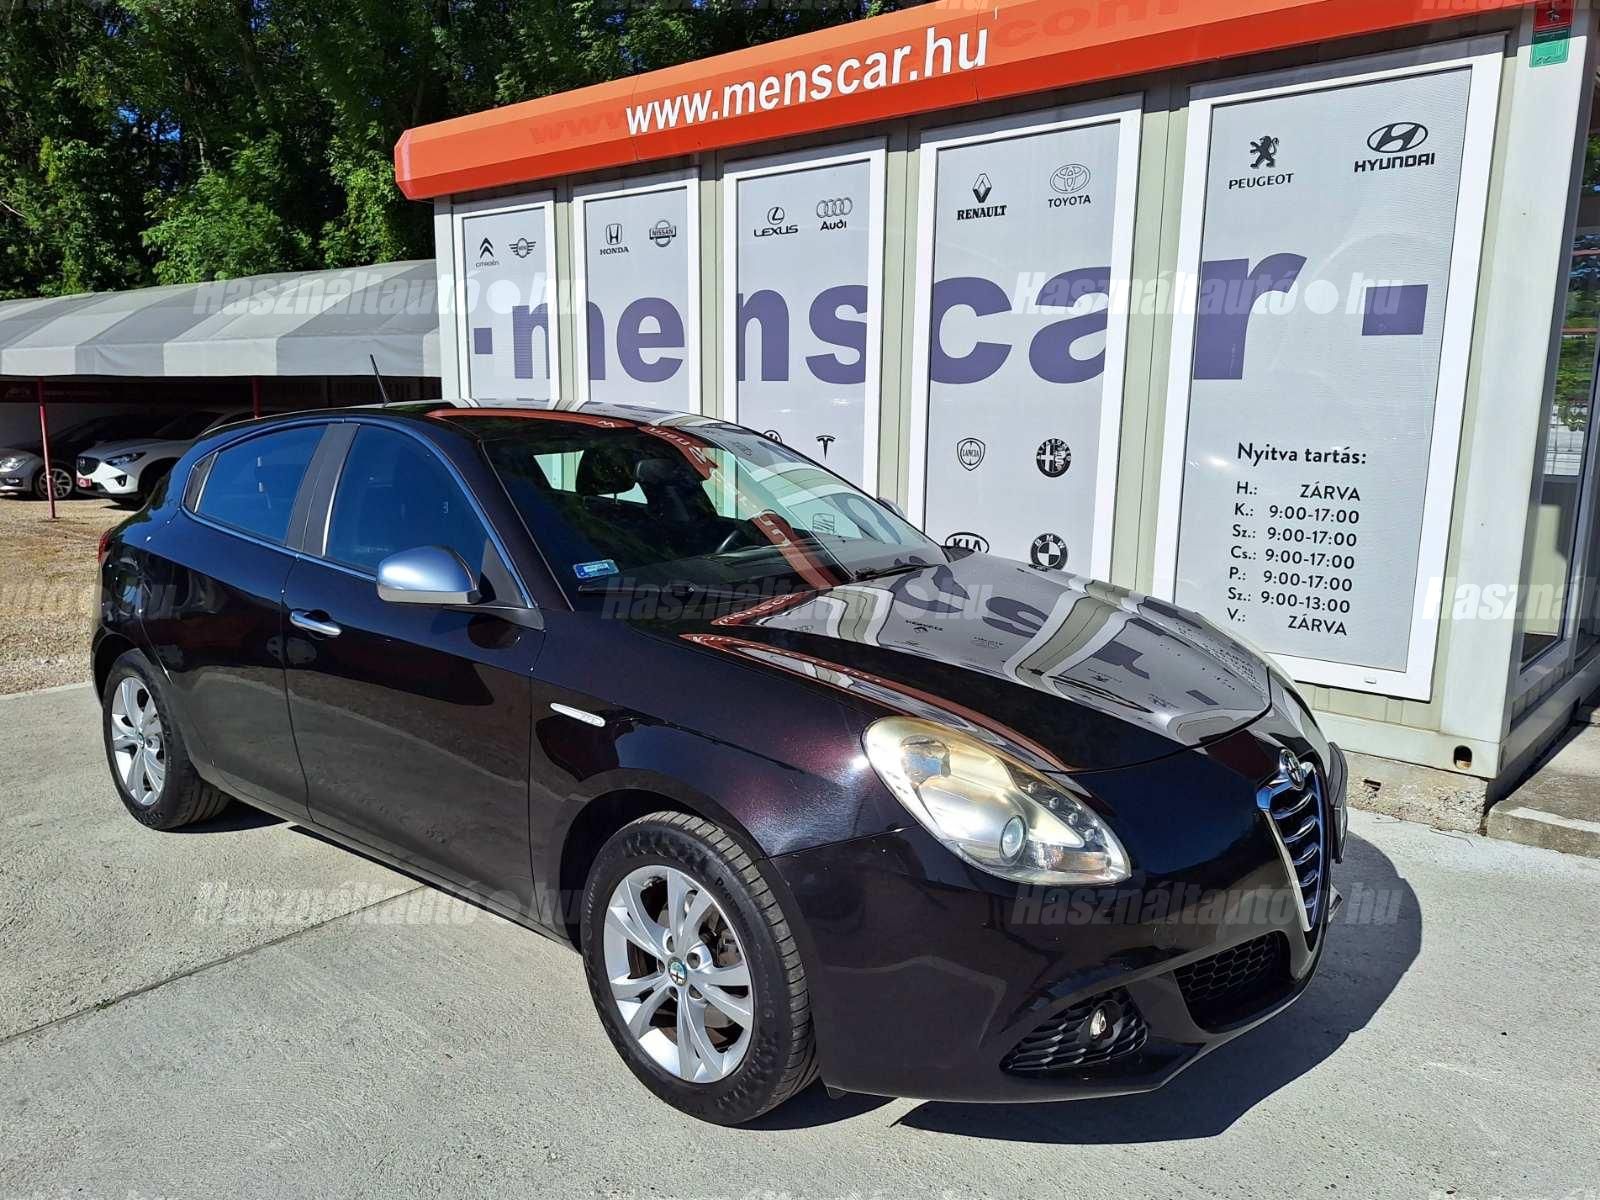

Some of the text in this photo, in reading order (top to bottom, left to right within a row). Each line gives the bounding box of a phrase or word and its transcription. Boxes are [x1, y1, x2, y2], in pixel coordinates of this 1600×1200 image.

[625, 27, 988, 136] www.menscar.hu
[1354, 153, 1435, 173] HYUNDAI
[1228, 173, 1294, 189] PEUGEOT
[1048, 195, 1091, 208] TOYOTA
[957, 205, 1007, 221] RENAULT
[651, 228, 674, 236] NISSAN
[753, 225, 799, 237] LEXUS
[820, 219, 847, 231] Audi
[600, 246, 630, 256] HONDA
[1237, 442, 1367, 467] Nyitva tartás:
[1236, 481, 1360, 501] H.: ZÁRVA
[1234, 503, 1359, 524] K.: 9:00-17:00
[953, 538, 982, 551] KIA
[1034, 534, 1066, 549] BMW
[1232, 524, 1357, 547] Sz.: 9:00-17:00
[1230, 546, 1355, 569] Cs.: 9:00-17:00
[1229, 566, 1352, 592] P.: 9:00-17:00
[1228, 587, 1350, 613] Sz.: 9:00-13:00
[1227, 607, 1347, 635] V.: ZÁRVA
